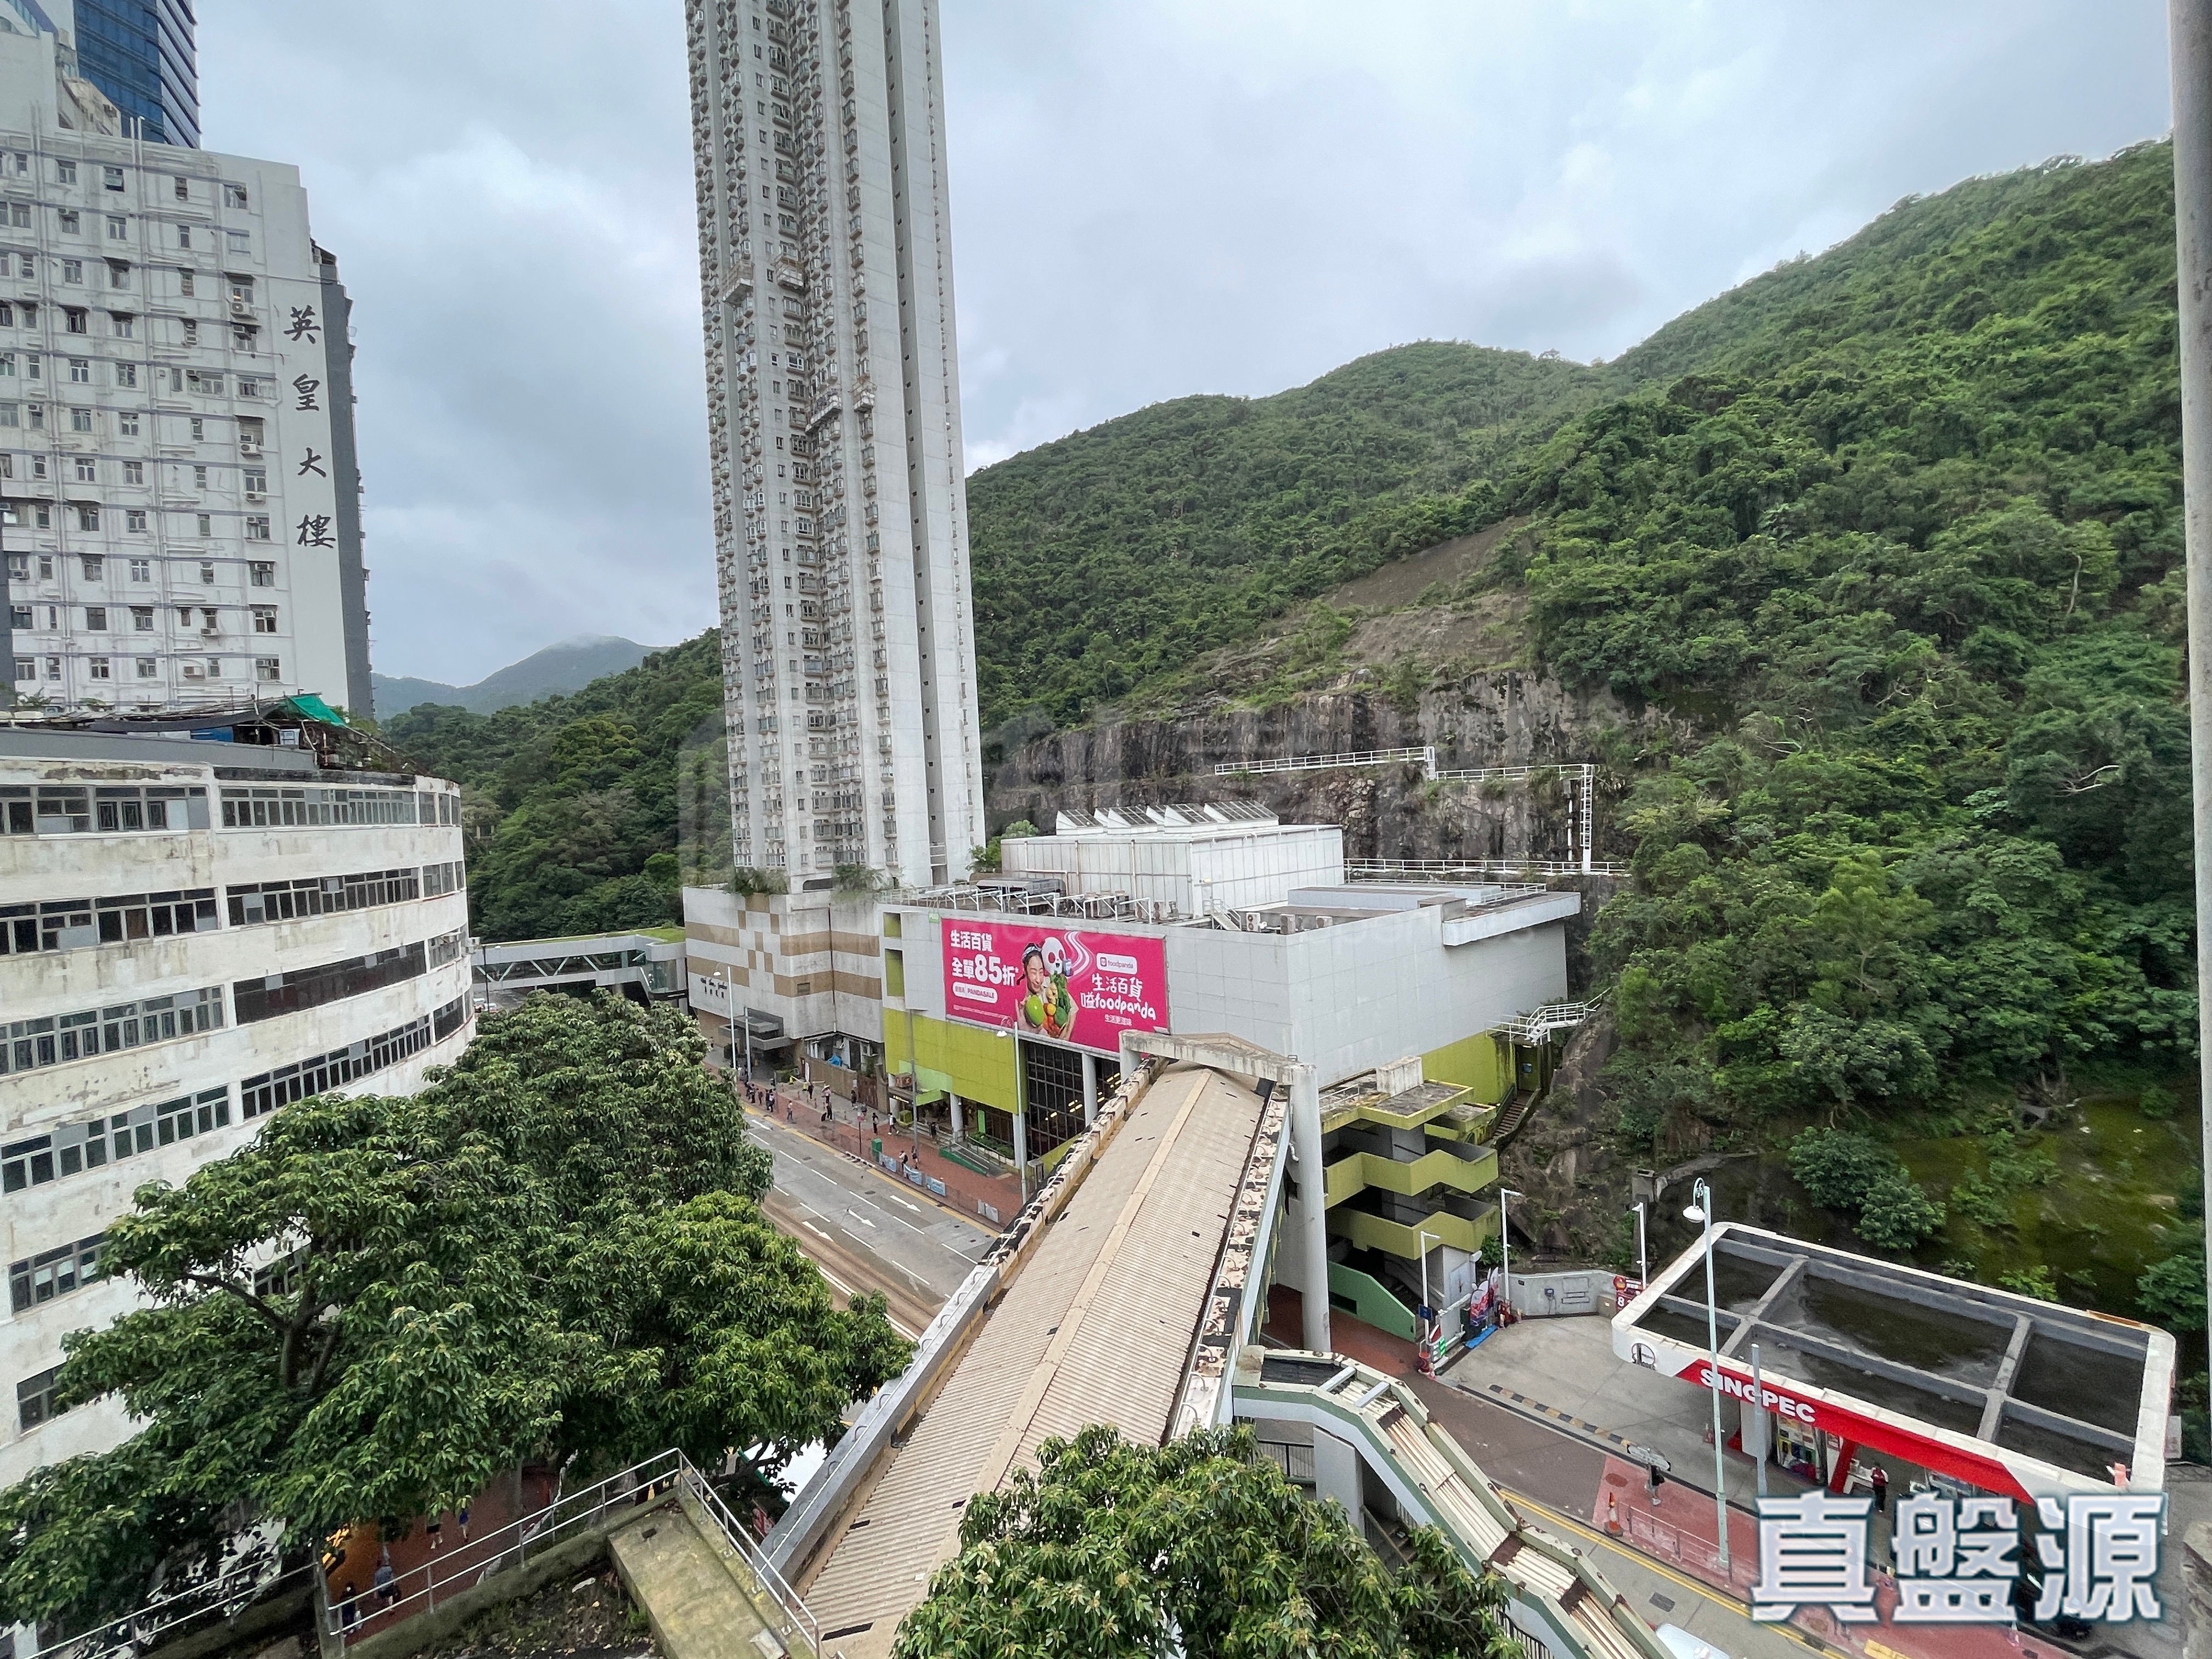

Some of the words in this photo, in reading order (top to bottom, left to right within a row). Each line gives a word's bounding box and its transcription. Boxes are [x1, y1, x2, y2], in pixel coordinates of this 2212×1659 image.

[284, 304, 336, 549] 英皇大樓
[950, 929, 992, 952] 生活百貨
[1108, 959, 1134, 969] foodpanda
[1092, 973, 1143, 1002] 生活百貨
[1700, 1368, 1816, 1423] SINOPEC
